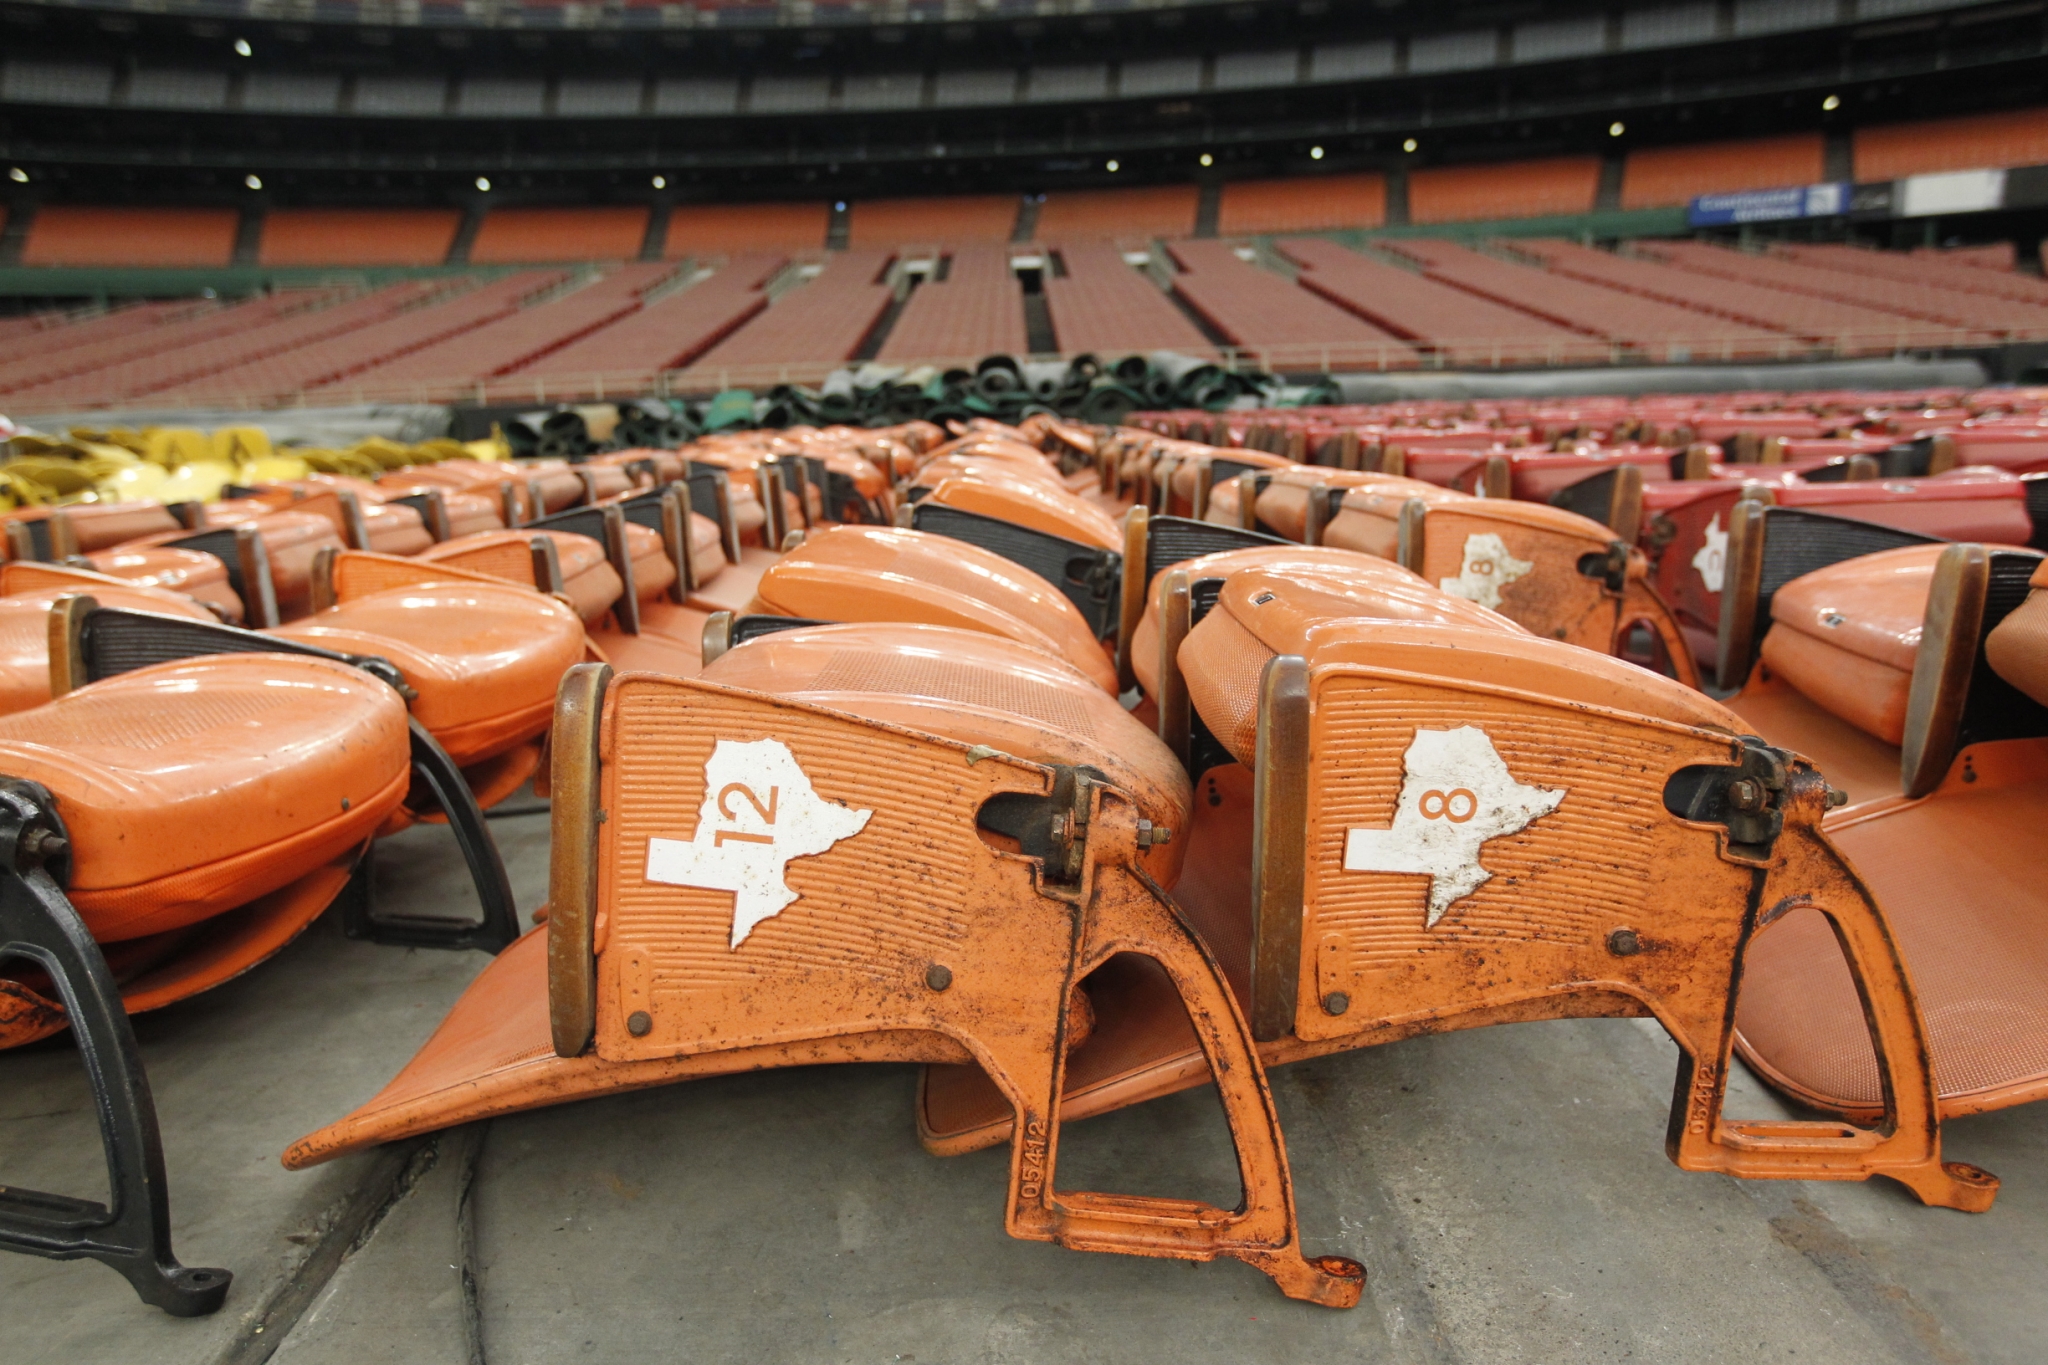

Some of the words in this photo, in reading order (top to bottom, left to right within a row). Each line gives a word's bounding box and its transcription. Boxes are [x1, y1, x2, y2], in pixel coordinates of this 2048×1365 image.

[1469, 559, 1494, 577] 8
[714, 781, 779, 848] 12
[1418, 787, 1478, 824] 8
[1020, 1120, 1049, 1199] 05412
